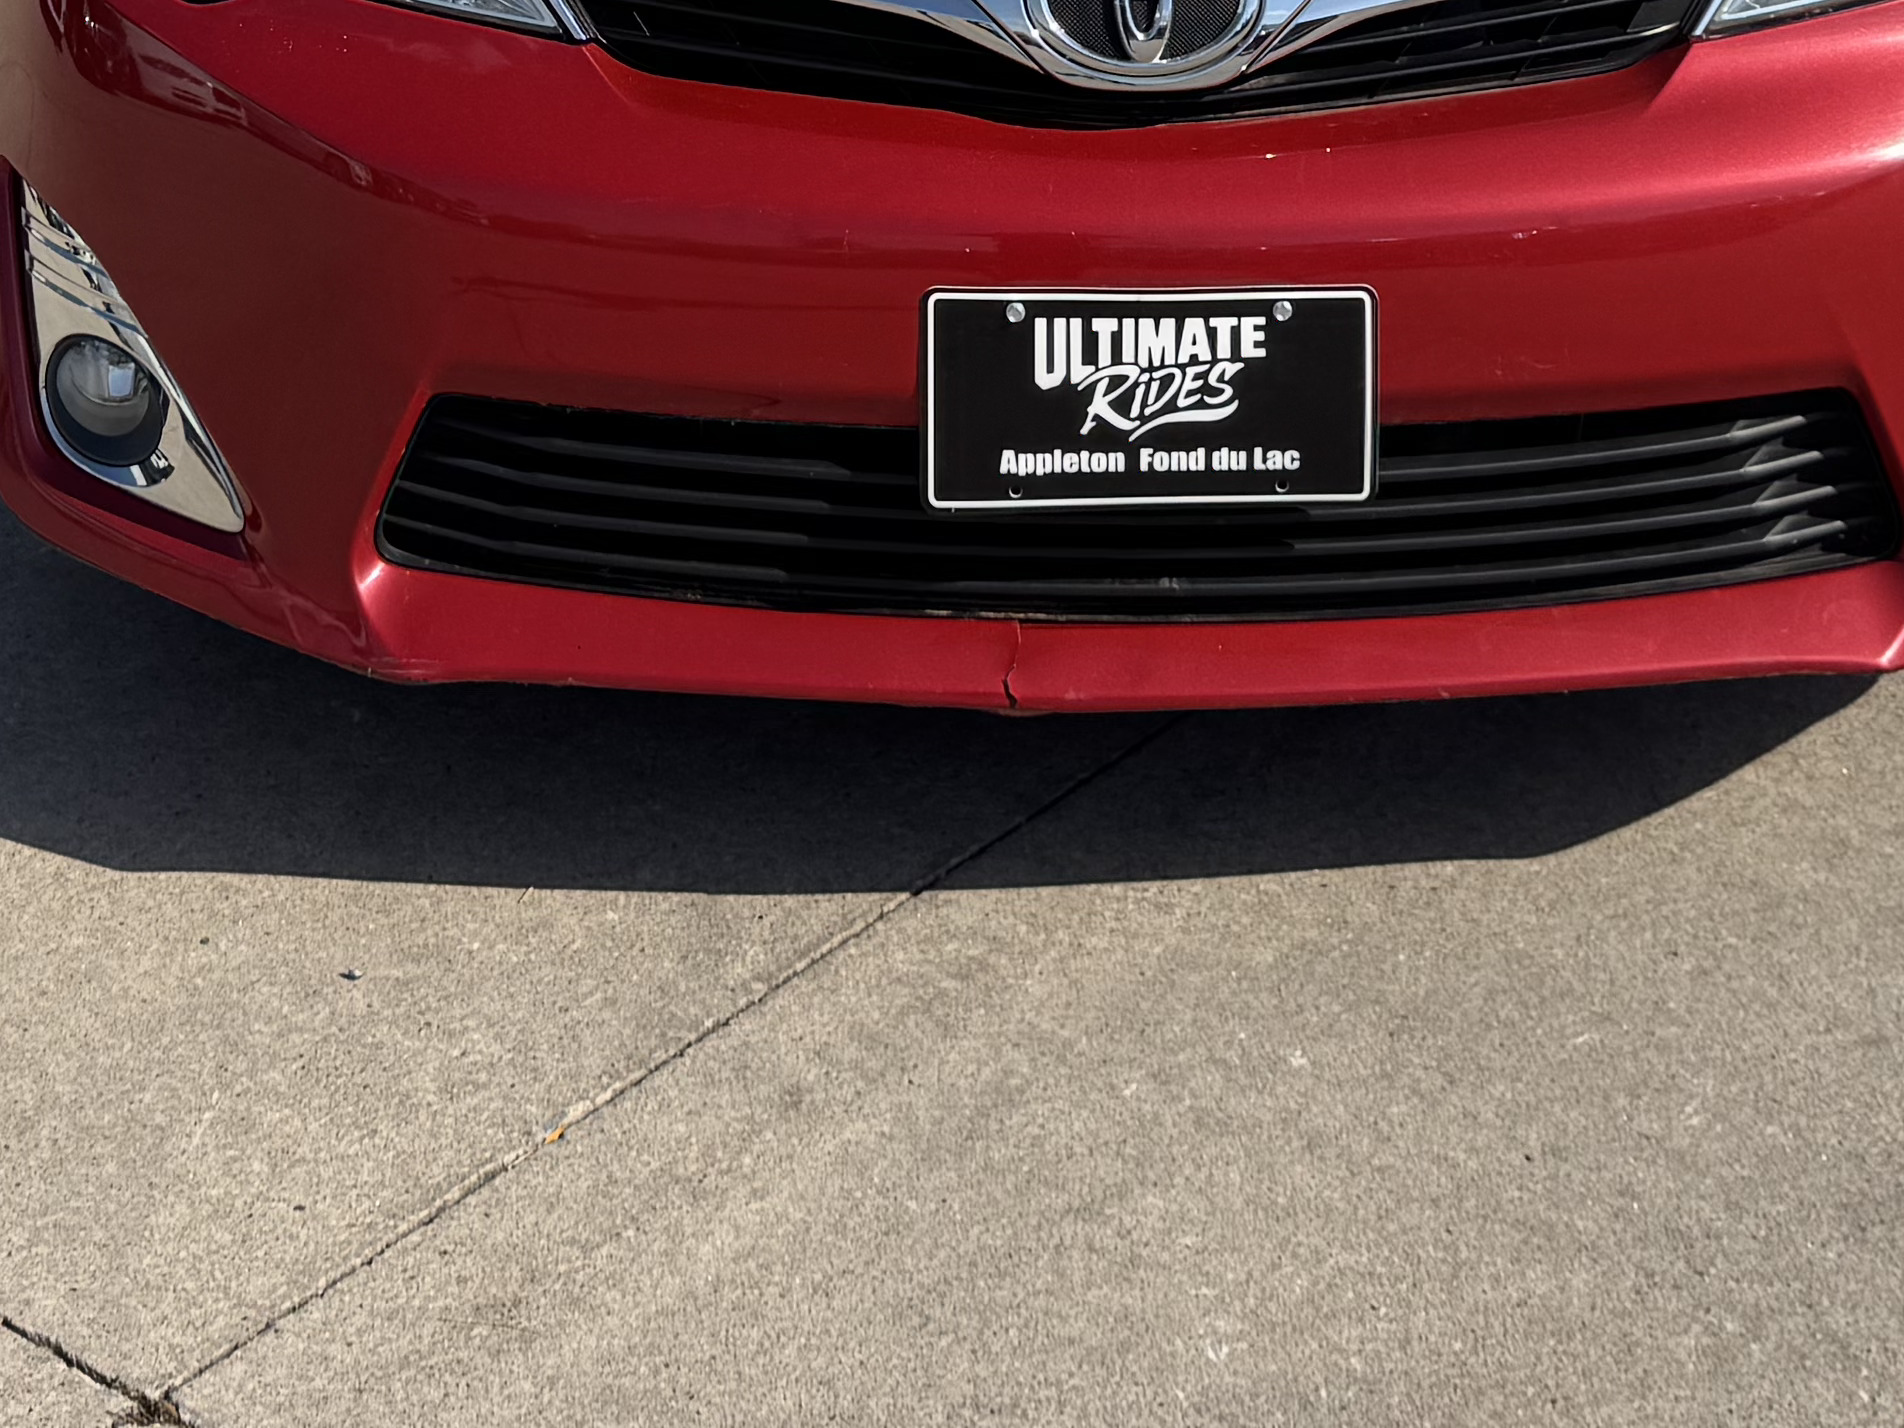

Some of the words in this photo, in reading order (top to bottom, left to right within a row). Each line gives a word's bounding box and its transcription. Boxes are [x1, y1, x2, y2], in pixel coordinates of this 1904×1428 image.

[1033, 316, 1267, 391] ULTIMATE
[999, 447, 1126, 477] Appleton
[1139, 447, 1206, 473] Fond
[1211, 446, 1248, 472] du
[1253, 446, 1301, 472] Lac
